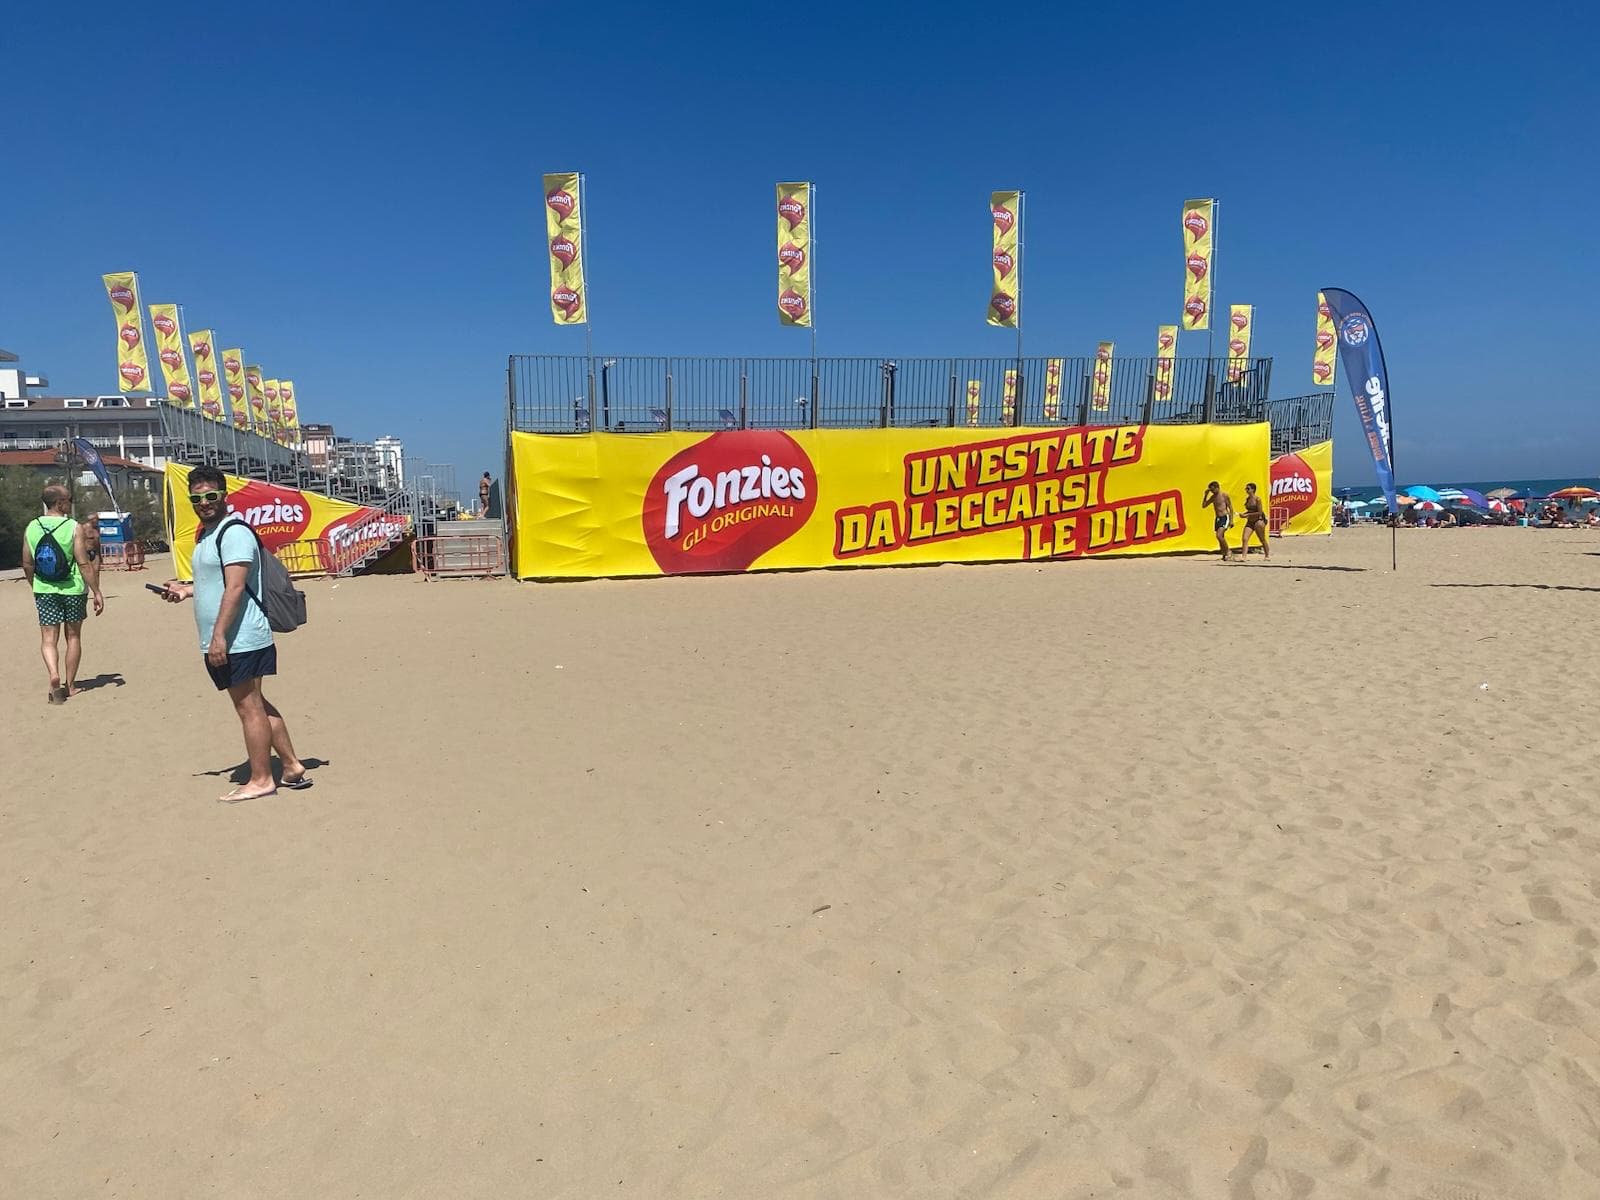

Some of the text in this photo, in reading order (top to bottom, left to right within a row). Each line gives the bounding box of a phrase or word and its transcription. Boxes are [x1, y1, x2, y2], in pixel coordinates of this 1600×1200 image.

[908, 426, 1138, 497] UN'ESTATE
[1271, 472, 1313, 496] nzies
[663, 454, 806, 539] Fonzies
[682, 504, 794, 551] GLI ORIGINALI
[840, 470, 1100, 554] DA LECCARSI
[1029, 498, 1181, 558] LE DITA
